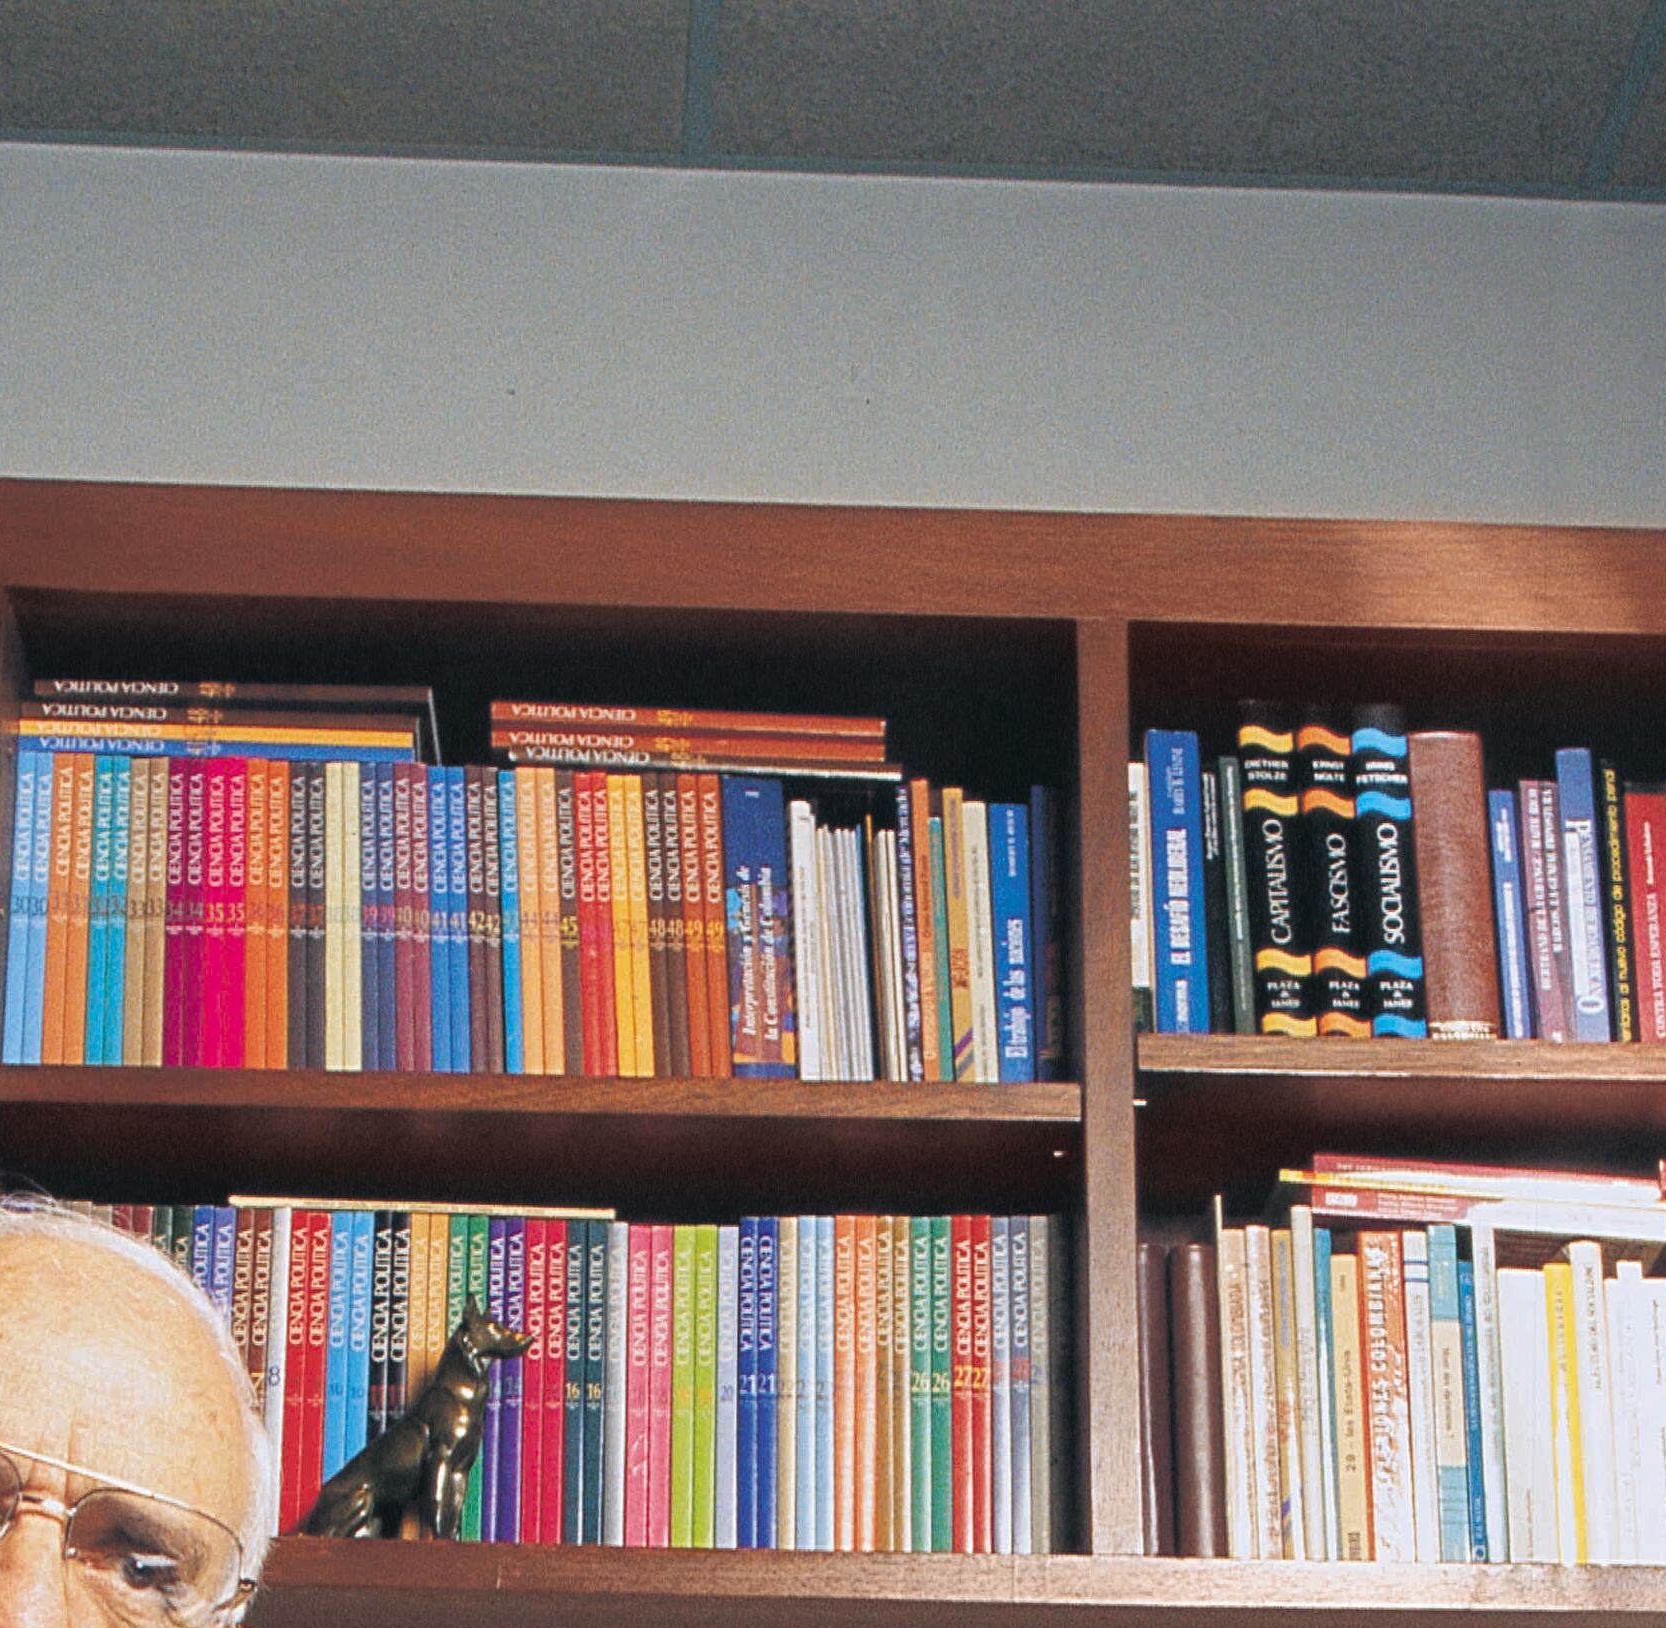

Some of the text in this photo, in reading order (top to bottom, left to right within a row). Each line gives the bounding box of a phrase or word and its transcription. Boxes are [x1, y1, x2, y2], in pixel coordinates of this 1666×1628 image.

[54, 681, 179, 694] CIENCIA POLITICA
[40, 737, 165, 750] CIENCIA POLITICA
[526, 747, 650, 764] CIENCIA POLITICA
[1605, 769, 1618, 801] penal
[168, 773, 183, 885] CIENCIA POLITICA
[229, 775, 244, 887] CIENCIA POLITICA
[396, 778, 411, 889] CIENCIA POLITICA
[559, 788, 575, 900] CIENCIA POLITICA
[1606, 805, 1623, 881] procedimiento
[703, 792, 721, 902] CIENCIA POLITICA
[736, 865, 750, 881] de
[1262, 819, 1291, 944] CAPITALISMO
[1326, 834, 1351, 933] FASCISMO
[1377, 823, 1405, 944] SOCIALISMO
[759, 866, 775, 926] Colombia
[1611, 885, 1623, 900] de
[206, 904, 224, 922] 35
[228, 903, 244, 921] 35
[561, 916, 578, 936] 45
[649, 919, 665, 936] 48
[1613, 904, 1626, 942] código
[1616, 946, 1627, 978] nuevo
[760, 946, 779, 1025] Constitución
[1268, 981, 1299, 990] PLAZA
[1329, 981, 1360, 990] PLAZA
[1380, 981, 1413, 990] PLAZA
[764, 1027, 779, 1041] la
[1002, 1006, 1031, 1045] trabajo
[290, 1228, 307, 1344] CIENCIA POLITICA
[391, 1229, 410, 1362] CIENCIA POLITICA
[914, 1236, 930, 1351] CIENCIA POLITICA
[974, 1241, 989, 1357] CIENCIA POLITICA
[566, 1384, 580, 1398] 16
[588, 1384, 601, 1398] 16
[740, 1374, 756, 1394] 21
[758, 1374, 775, 1393] 21
[954, 1366, 971, 1387] 27
